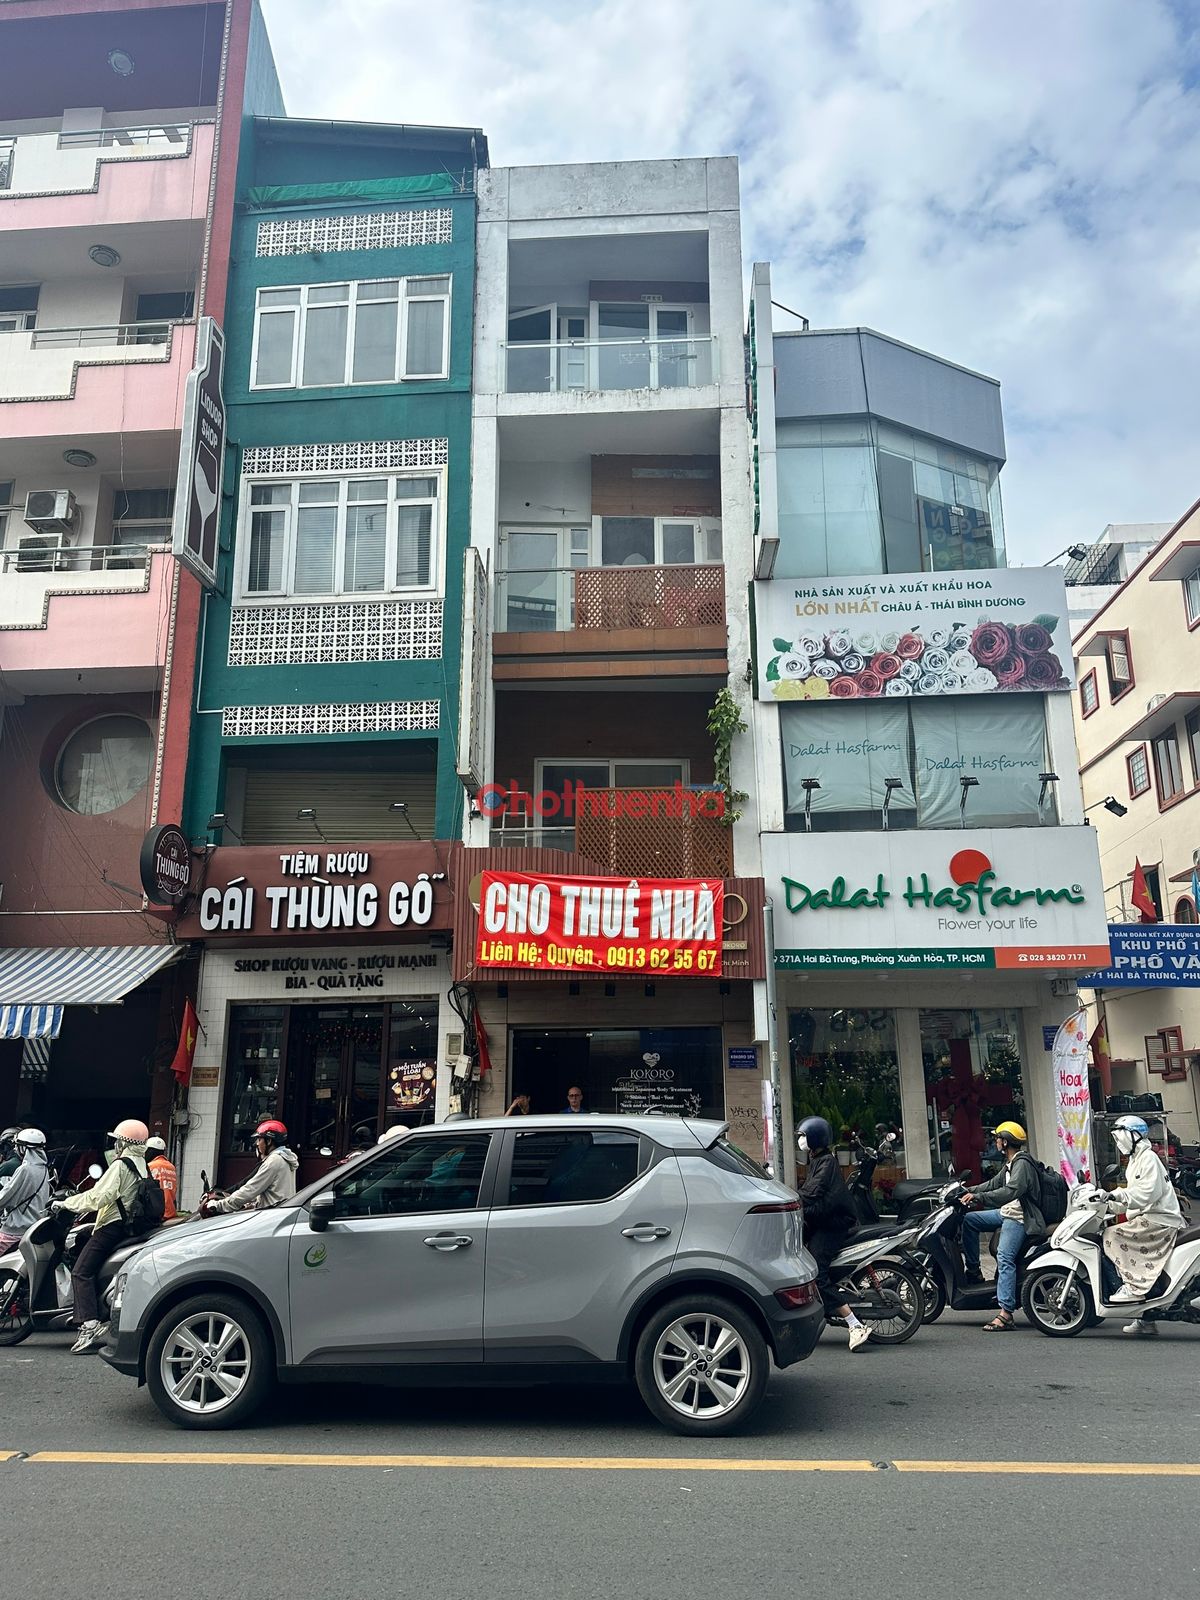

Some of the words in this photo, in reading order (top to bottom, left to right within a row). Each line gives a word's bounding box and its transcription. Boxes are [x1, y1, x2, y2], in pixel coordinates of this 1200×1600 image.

[201, 388, 222, 430] LIQUOR
[201, 418, 218, 449] SHOP
[795, 588, 818, 598] NHÀ
[823, 585, 844, 596] SẢN
[848, 584, 876, 595] XUẤT
[880, 583, 895, 594] VÀ
[900, 580, 929, 593] XUẤT
[932, 578, 962, 591] KHẨU
[967, 580, 992, 589] HOA
[796, 601, 829, 616] LỚN
[835, 596, 879, 614] NHẤT
[881, 601, 912, 612] CHÂU
[915, 600, 922, 611] Á
[931, 598, 954, 610] THÁI
[958, 597, 982, 608] BÌNH
[986, 597, 1025, 607] DƯƠNG
[790, 743, 831, 758] Dalat
[925, 756, 966, 771] Dalat
[280, 851, 318, 877] TIỆM
[326, 852, 368, 877] RƯỢU
[200, 876, 254, 930] CÁI
[266, 876, 378, 929] THÙNG
[388, 873, 444, 926] GỖ
[781, 874, 890, 914] Dalat
[484, 882, 550, 934] CHO
[561, 880, 640, 938] THUÊ
[650, 883, 716, 941] NHÀ
[938, 917, 982, 930] Flower
[984, 919, 1015, 932] your
[1019, 916, 1038, 929] life
[1122, 940, 1150, 950] KHU
[1156, 938, 1186, 950] PHỐ
[234, 958, 269, 972] SHOP
[272, 958, 309, 974] RƯỢU
[312, 958, 347, 970] VANG
[358, 956, 394, 972] RƯỢU
[398, 954, 436, 971] MẠNH
[481, 941, 513, 962] Liên
[518, 942, 542, 966] Hệ:
[547, 943, 593, 965] Quyên
[607, 946, 645, 967] 0913
[650, 948, 668, 967] 62
[674, 949, 693, 969] 55
[698, 950, 717, 969] 67
[780, 955, 801, 963] 371A
[820, 953, 831, 962] Bà
[833, 955, 860, 965] Trưng,
[861, 953, 894, 964] Phường
[898, 954, 920, 962] Xuân
[924, 953, 944, 963] Hòa,
[947, 954, 960, 962] TP.
[962, 954, 985, 962] HCM
[1114, 952, 1164, 968] PHỐ
[285, 976, 307, 989] BIA
[317, 972, 346, 990] QUÀ
[348, 974, 383, 991] TẶNG
[1127, 970, 1140, 979] BÀ
[1143, 972, 1180, 980] TRƯNG,
[630, 1069, 675, 1080] KOKORO
[1060, 1070, 1082, 1086] Hoa
[1060, 1092, 1083, 1106] Xinh
